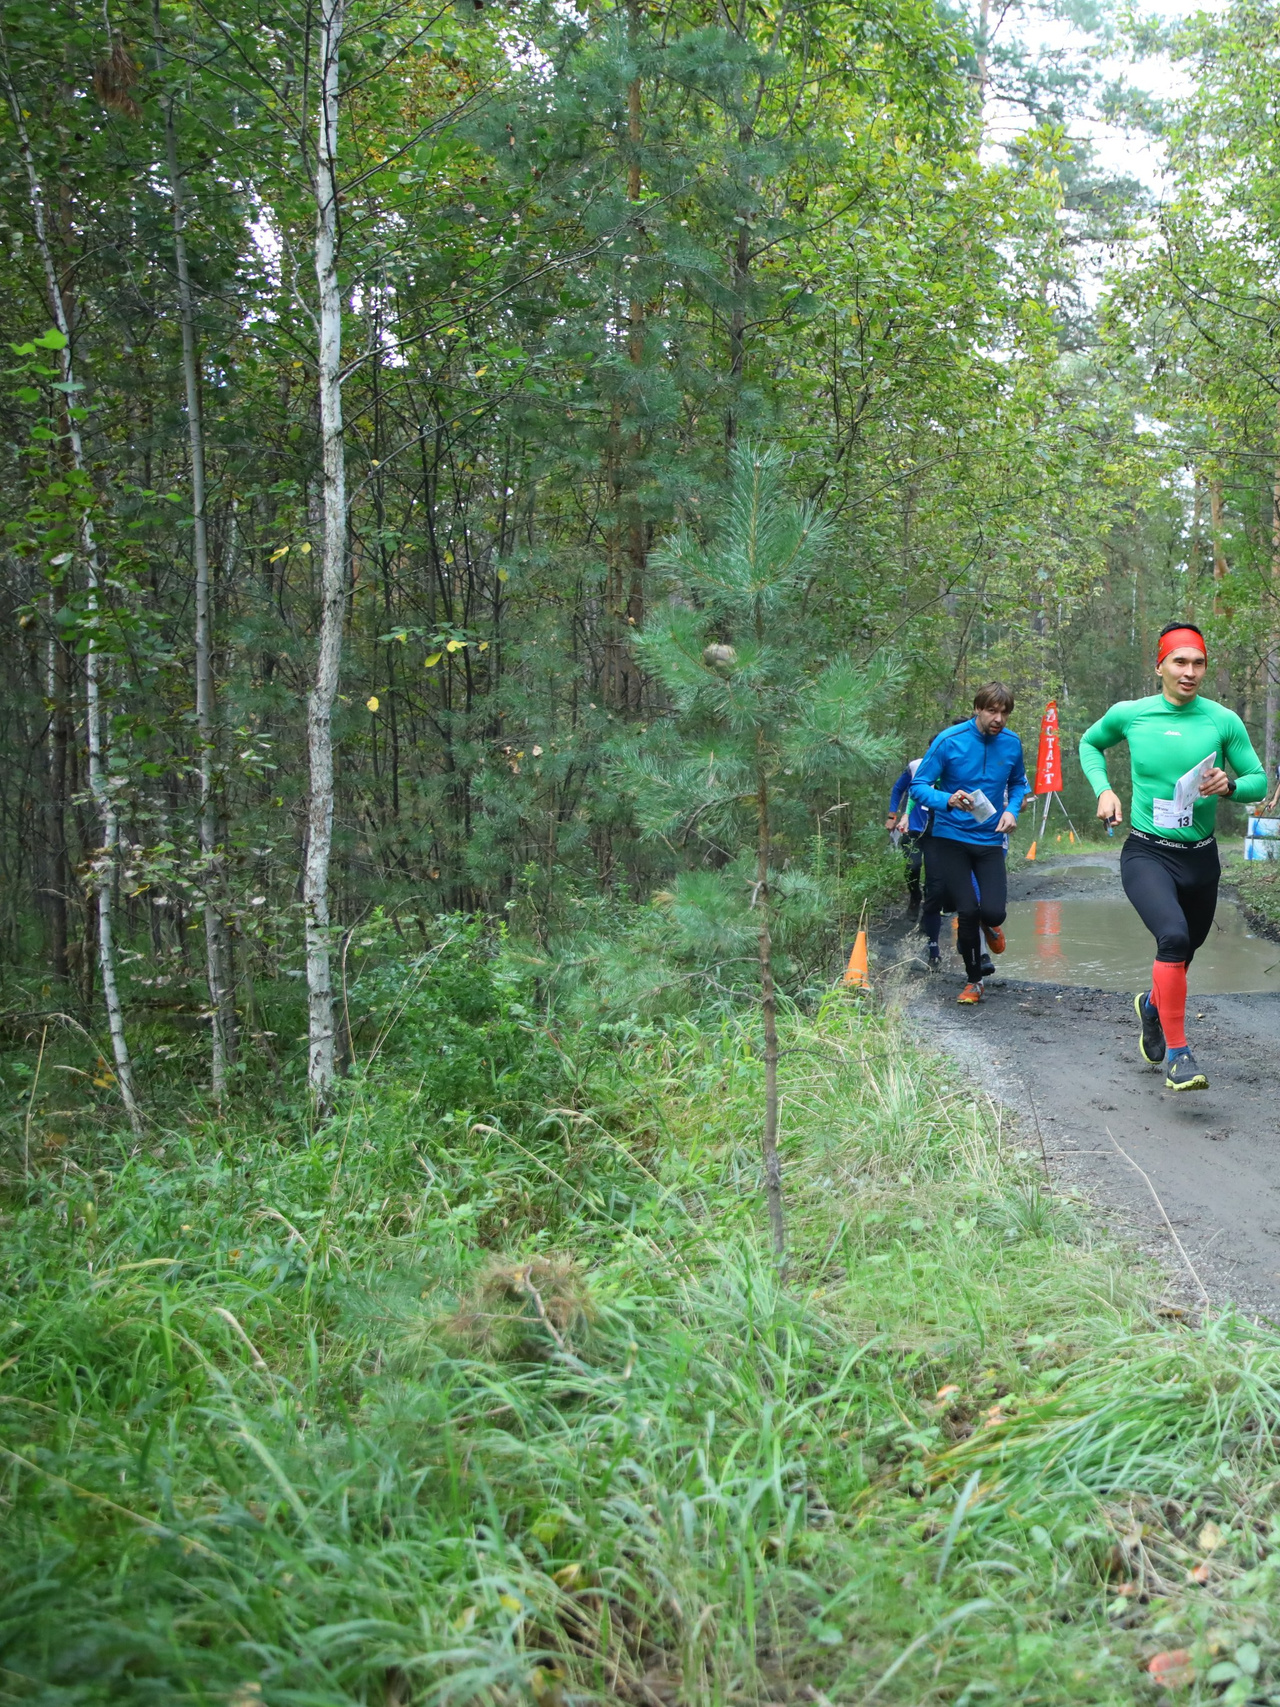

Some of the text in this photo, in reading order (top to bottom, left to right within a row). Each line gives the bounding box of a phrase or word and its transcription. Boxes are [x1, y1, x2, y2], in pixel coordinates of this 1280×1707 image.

[1044, 725, 1055, 784] СТАРТ
[1177, 816, 1190, 828] 13
[1155, 838, 1188, 849] JÖGEL
